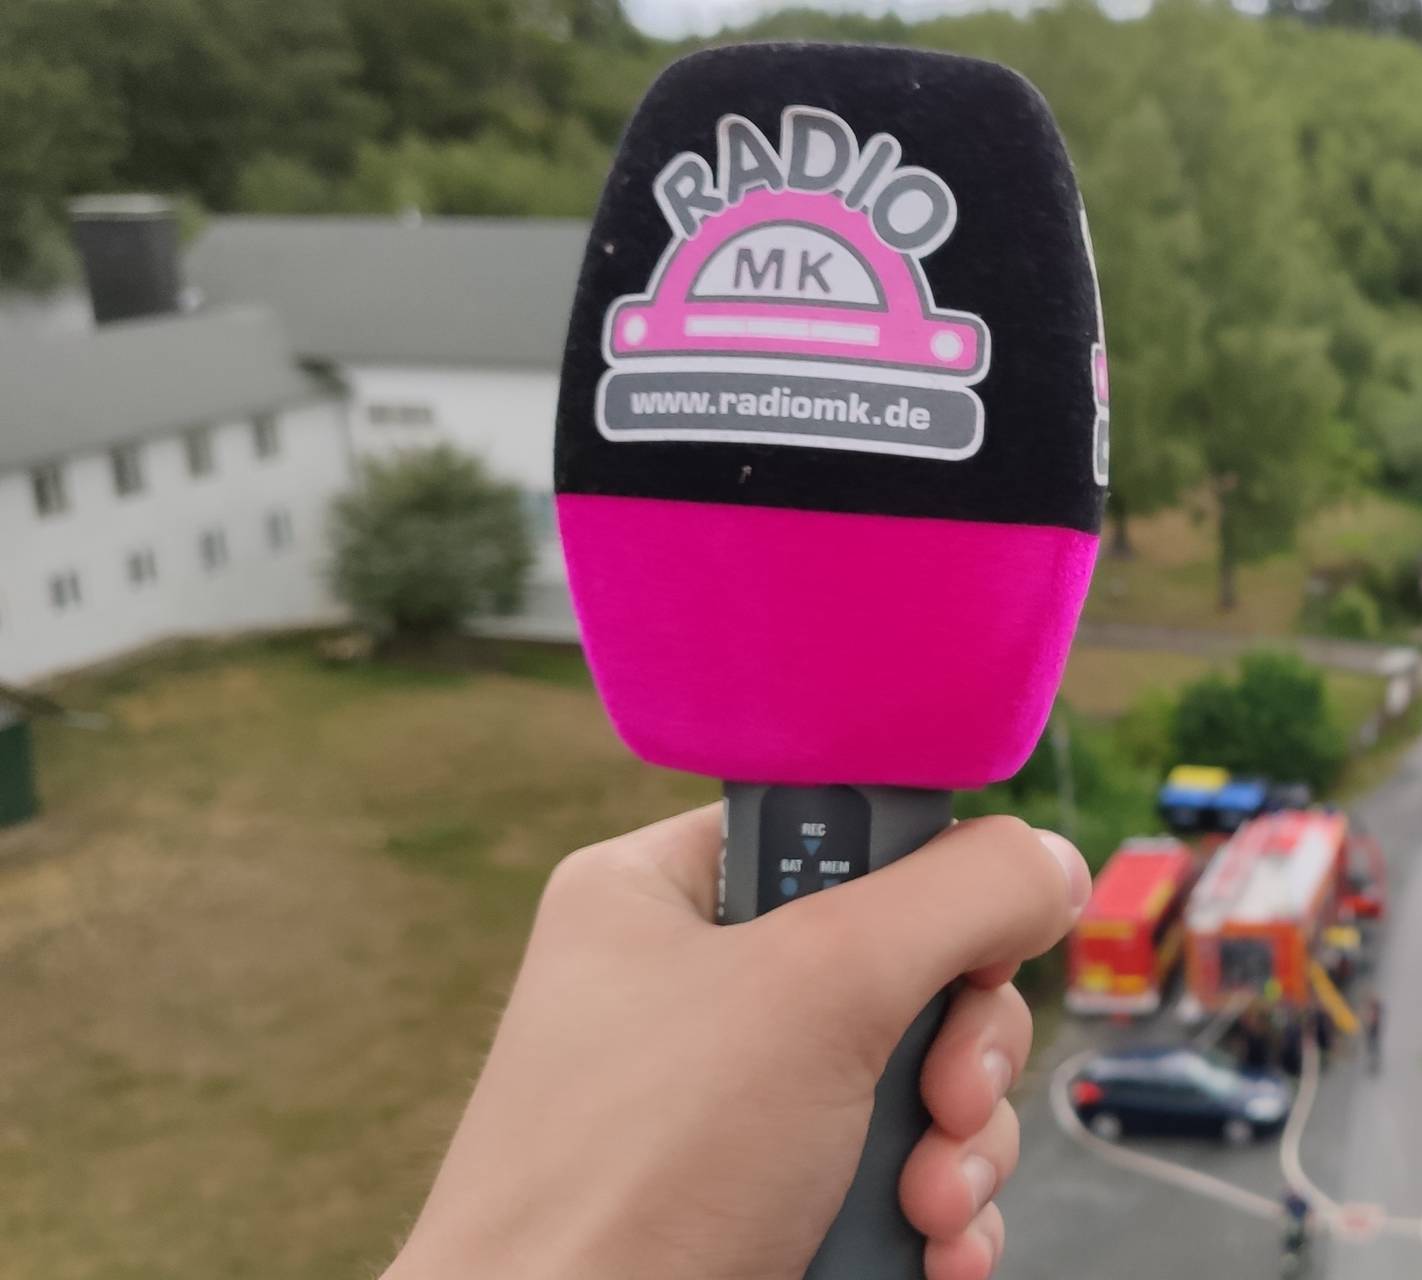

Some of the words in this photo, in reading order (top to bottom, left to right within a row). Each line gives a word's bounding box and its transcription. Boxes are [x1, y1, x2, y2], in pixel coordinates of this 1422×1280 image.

[661, 112, 952, 252] RADIO
[733, 247, 834, 294] MK
[631, 386, 932, 431] www.radiomk.de
[801, 822, 828, 837] REC
[780, 858, 803, 872] BAT
[819, 860, 851, 874] MEM
